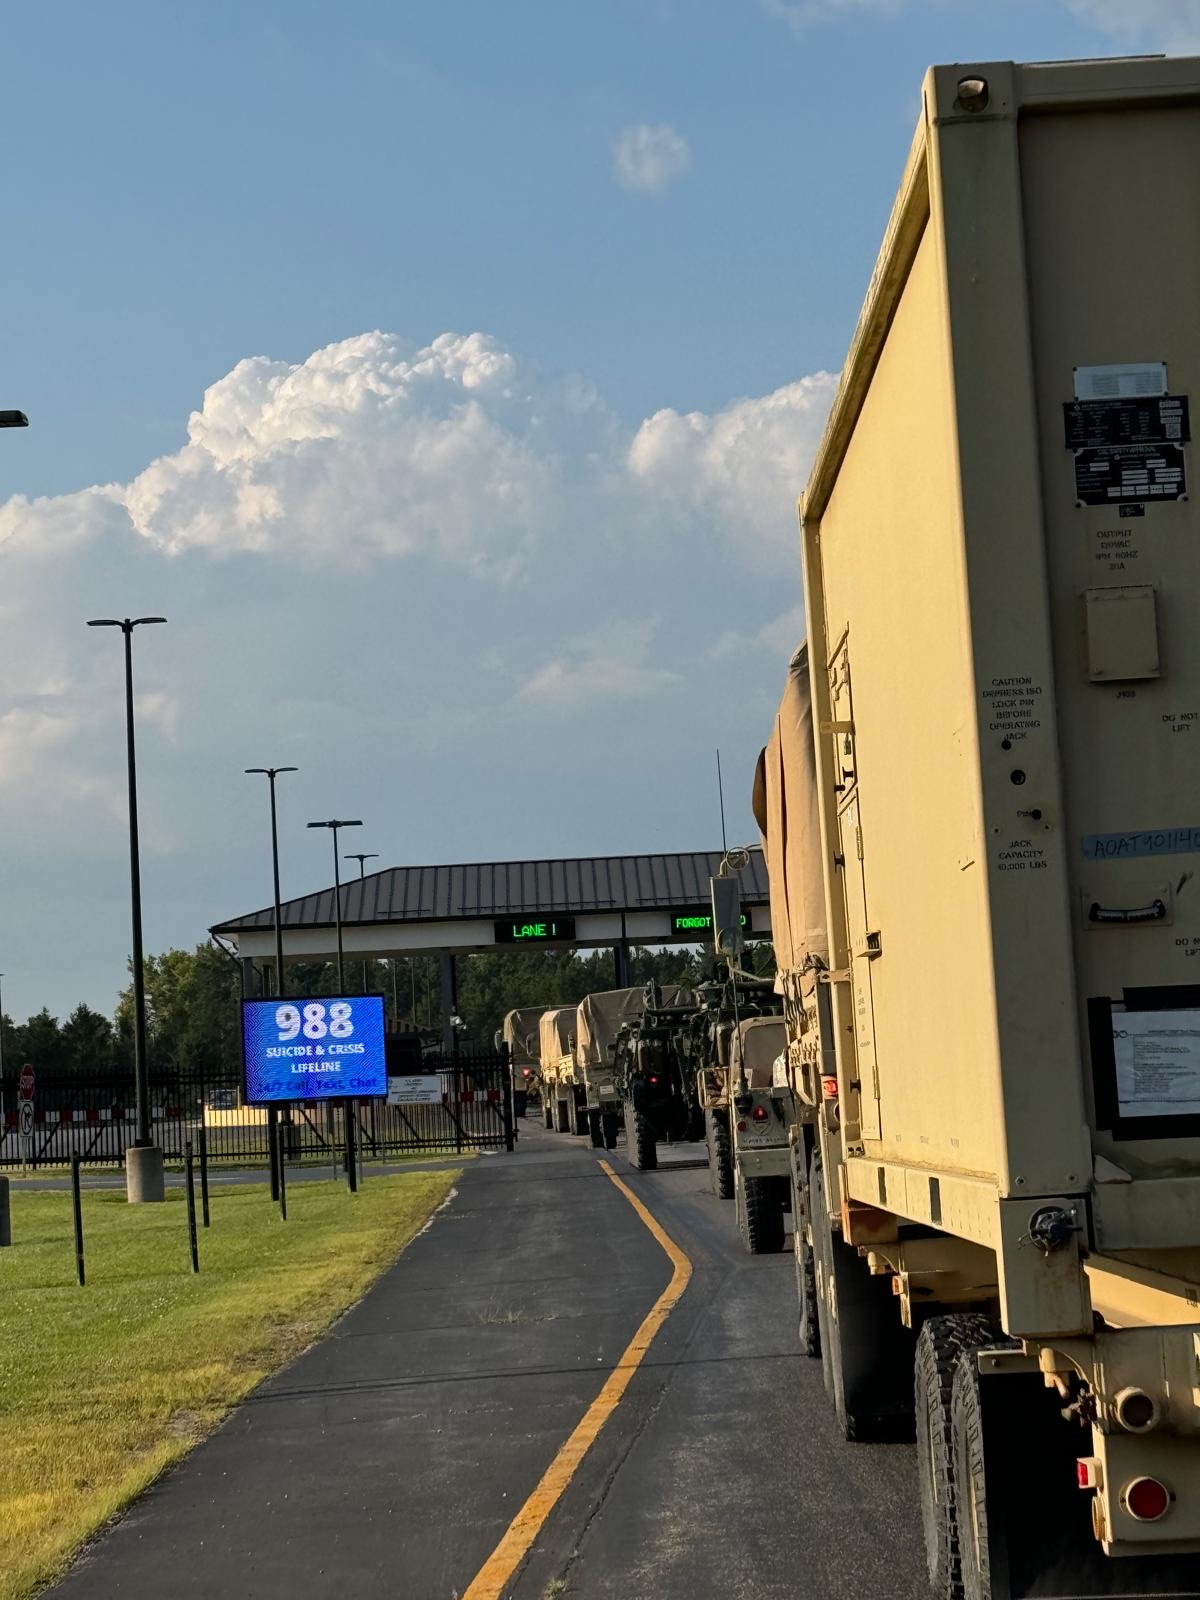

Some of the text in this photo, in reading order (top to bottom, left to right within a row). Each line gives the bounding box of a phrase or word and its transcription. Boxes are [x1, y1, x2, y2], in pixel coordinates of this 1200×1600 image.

[1096, 529, 1132, 538] OUTPUT
[992, 677, 1031, 686] CAUTION
[982, 687, 1042, 698] DEPRESS ISO
[992, 700, 1017, 708] LOCK
[996, 709, 1032, 719] BEFORE
[1162, 712, 1198, 722] DO NOT
[989, 720, 1041, 730] OPERATING
[1172, 724, 1191, 732] LIFT
[1004, 732, 1027, 741] JACK
[1009, 840, 1032, 848] JACK
[998, 850, 1044, 860] CAPACITY
[1029, 861, 1047, 869] LBS
[676, 917, 711, 928] FORGOT
[513, 924, 547, 937] LANE
[1175, 938, 1189, 946] DO
[275, 1002, 354, 1041] 988
[266, 1043, 365, 1058] SUICIDE & CRISIS
[291, 1061, 342, 1073] LIFELINE
[350, 1077, 377, 1088] Chat
